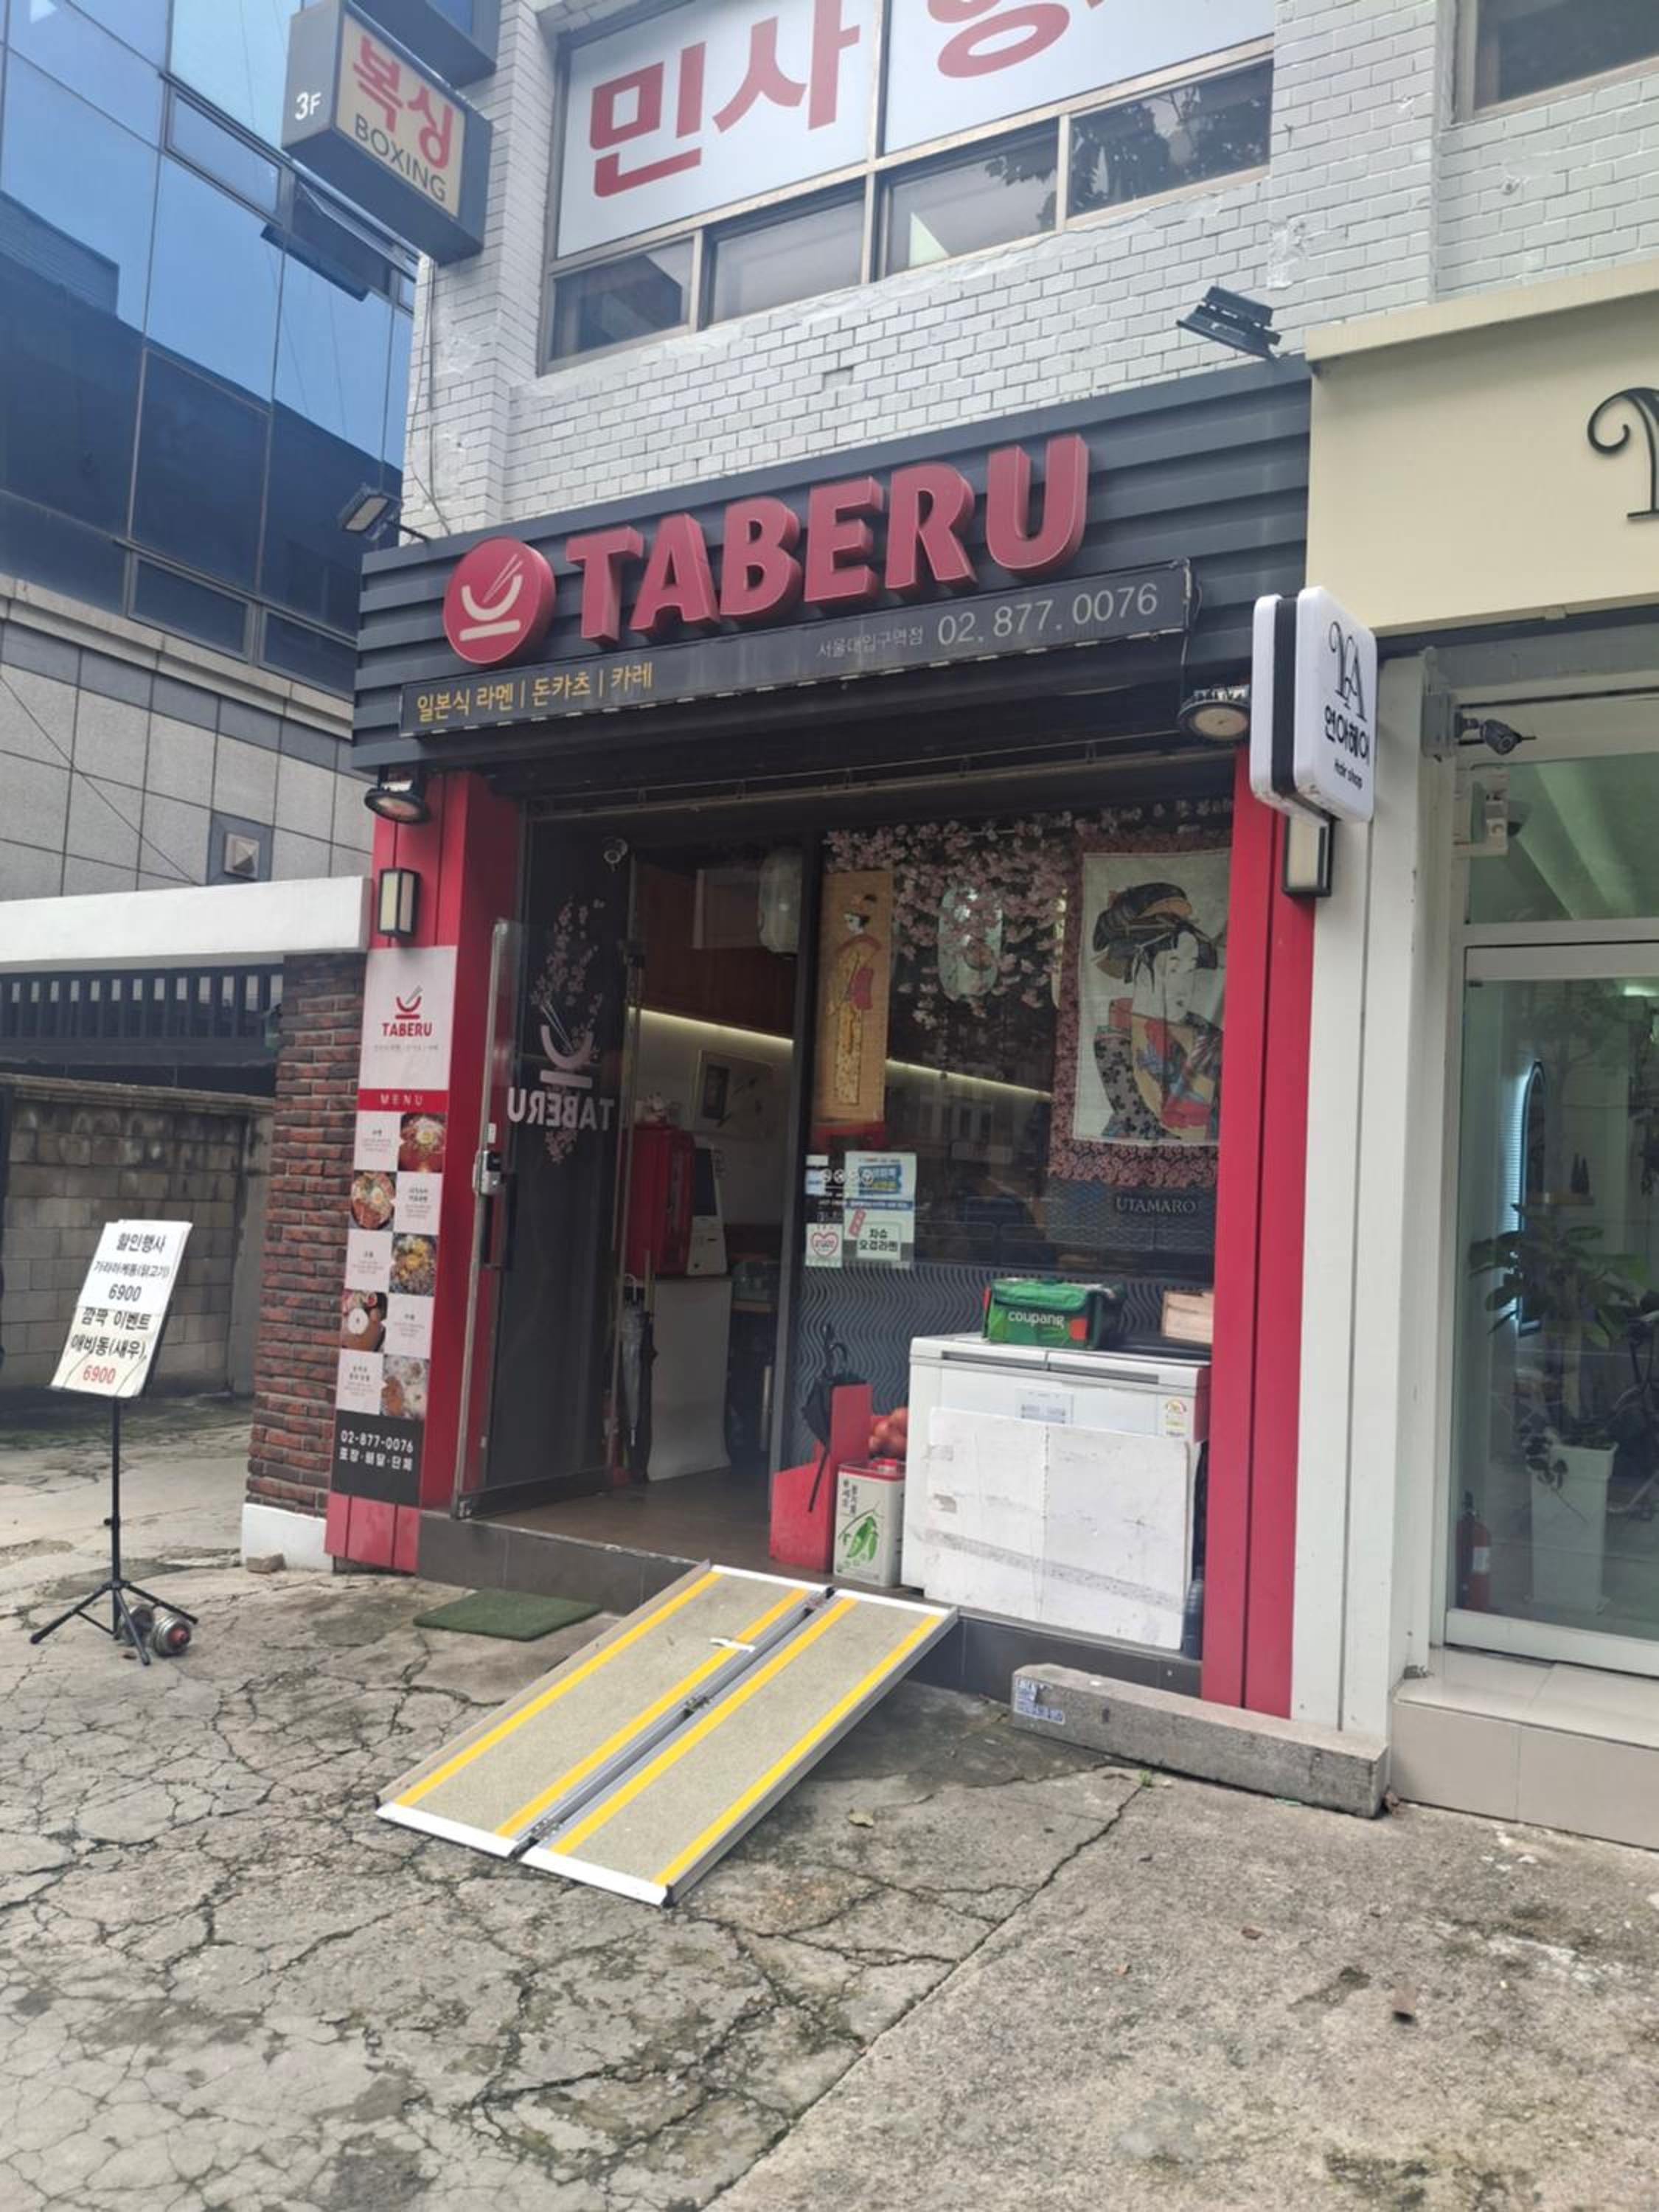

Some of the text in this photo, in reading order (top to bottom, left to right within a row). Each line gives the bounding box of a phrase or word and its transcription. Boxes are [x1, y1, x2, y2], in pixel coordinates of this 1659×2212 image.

[295, 91, 322, 121] 3F
[353, 35, 453, 170] 복싱
[591, 0, 860, 197] 민사
[355, 113, 446, 203] BOXING
[566, 433, 1091, 644] TABERU
[417, 662, 653, 723] 일본식 라멘 돈카츠 카레
[382, 1022, 434, 1037] TABERU
[380, 1093, 424, 1107] MENU
[1116, 1197, 1197, 1214] UTAMARO
[116, 1232, 166, 1253] 할인행사
[108, 1284, 142, 1301] 6900
[113, 1312, 153, 1331] 이벤트
[1007, 1310, 1065, 1330] coupang
[83, 1364, 116, 1385] 6900
[339, 1430, 415, 1455] 02-877-0076
